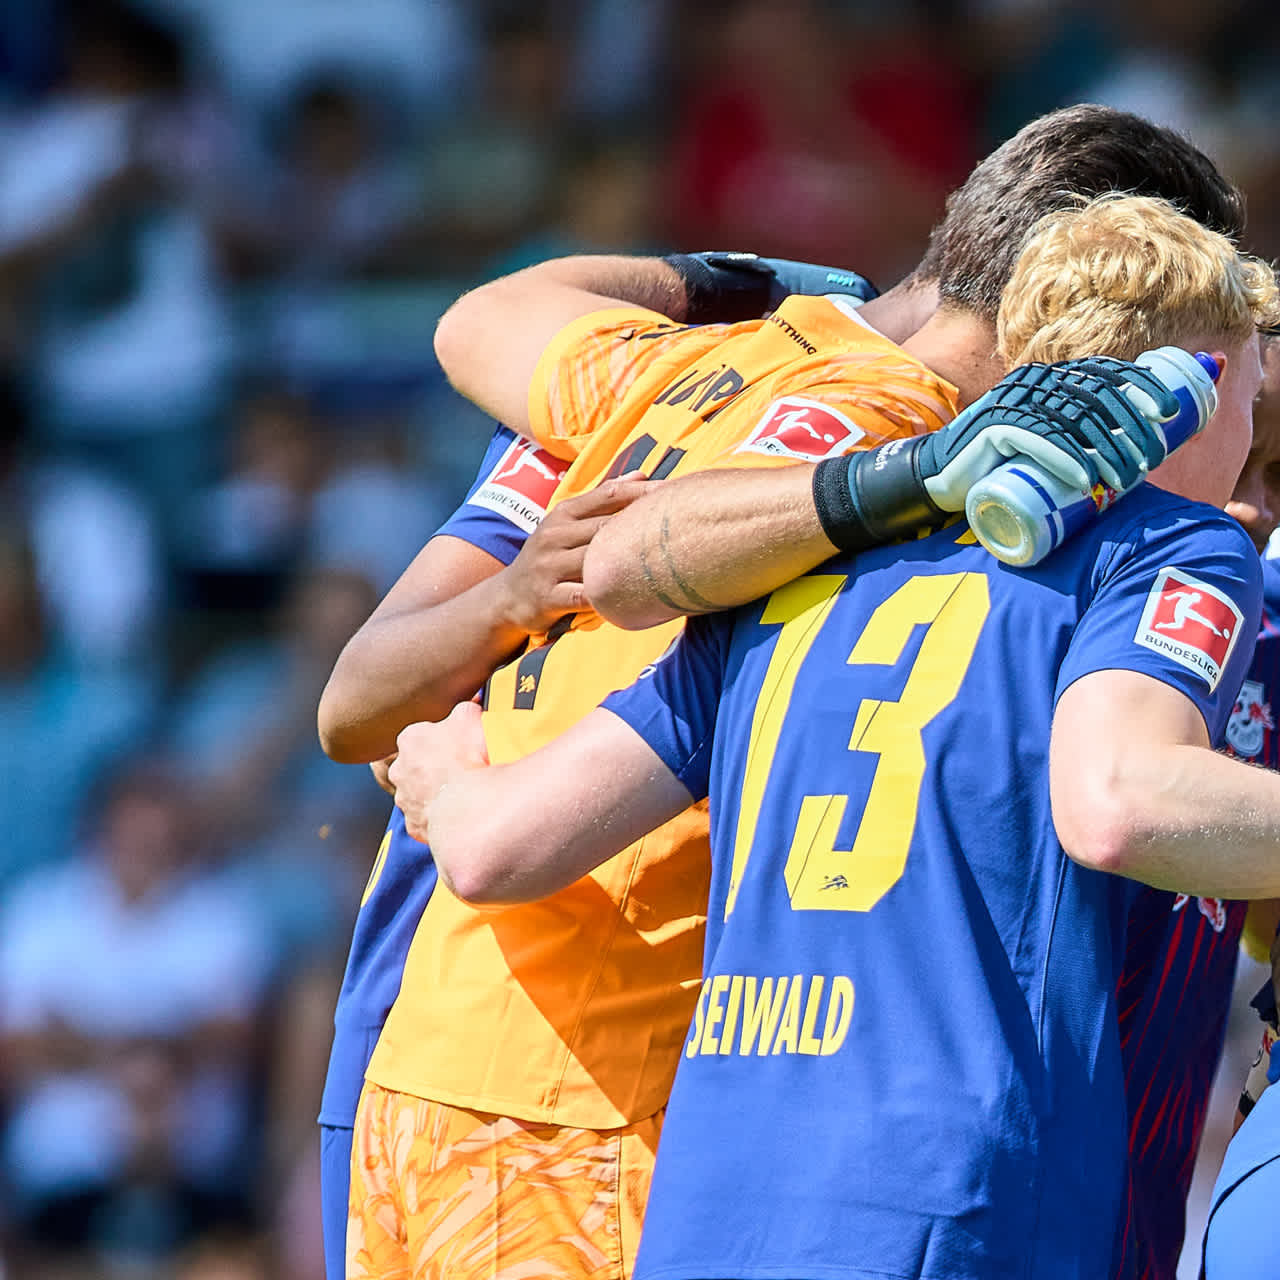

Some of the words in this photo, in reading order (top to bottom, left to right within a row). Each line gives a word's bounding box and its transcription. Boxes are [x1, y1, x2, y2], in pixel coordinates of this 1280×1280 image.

[1144, 634, 1218, 682] BUNDESLIGA
[724, 572, 991, 923] 13
[686, 974, 855, 1059] SEIWALD
